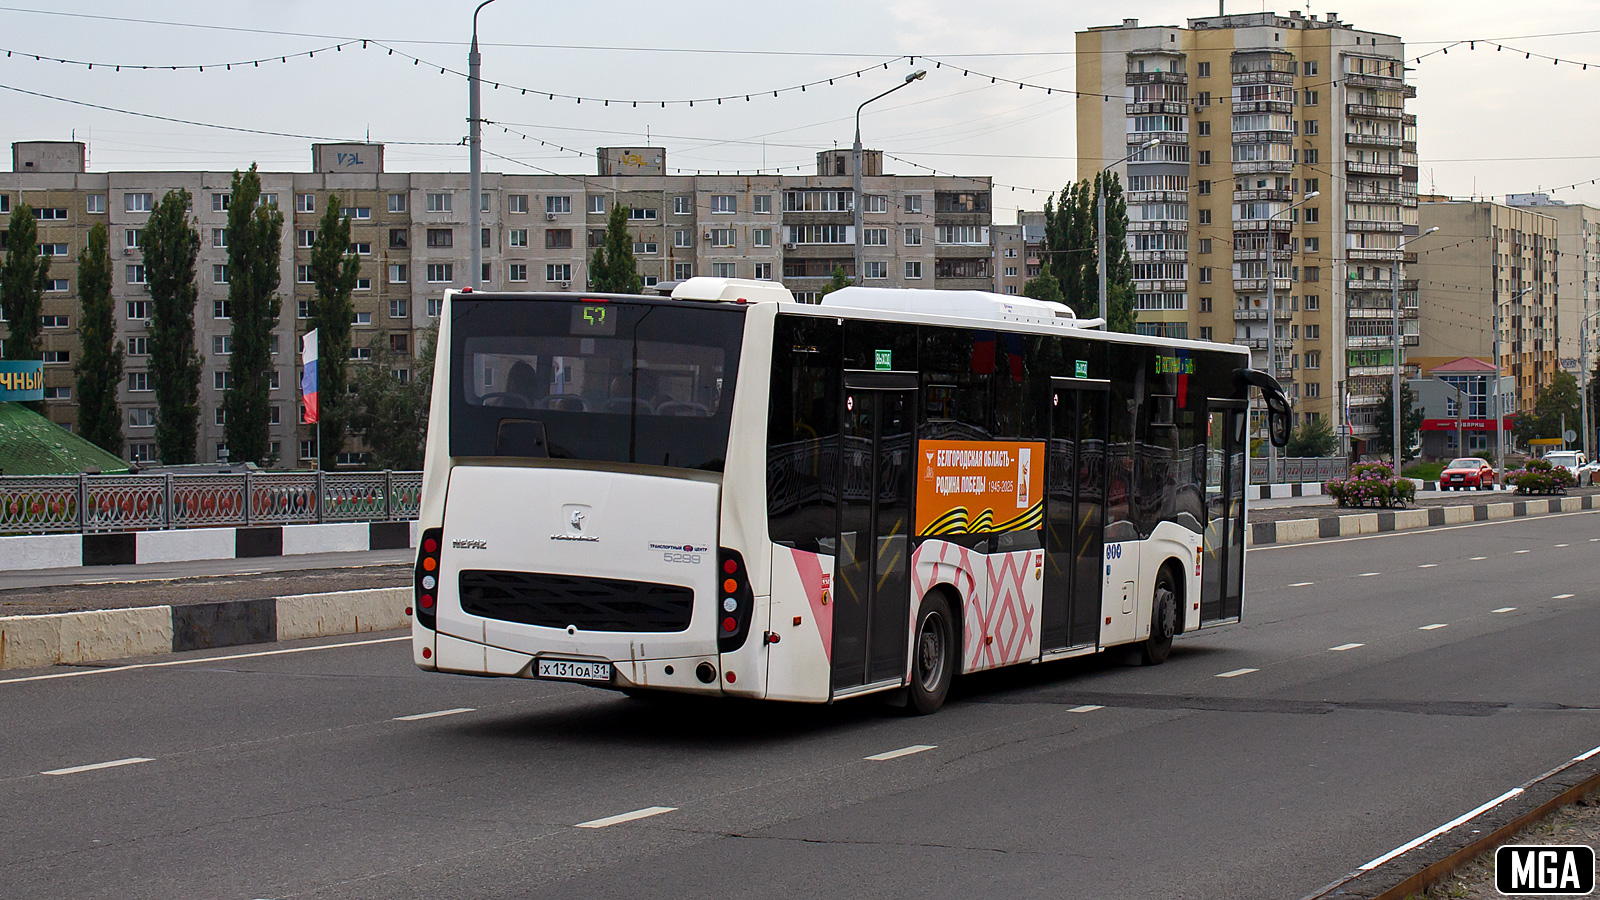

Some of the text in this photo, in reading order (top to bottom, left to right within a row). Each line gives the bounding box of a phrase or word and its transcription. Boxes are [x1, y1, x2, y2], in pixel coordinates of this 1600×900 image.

[937, 450, 983, 469] БЕЛГОРОДСКАЯ
[984, 450, 1010, 467] ОБЛАСТЬ
[936, 476, 960, 496] РОДИНА
[961, 476, 986, 495] ПОБЕДЫ
[988, 480, 1014, 493] 1945-2025
[452, 538, 487, 550] NEFAZ
[650, 543, 683, 551] ТРАНСПОРТНЫЙ
[663, 552, 701, 565] 5299
